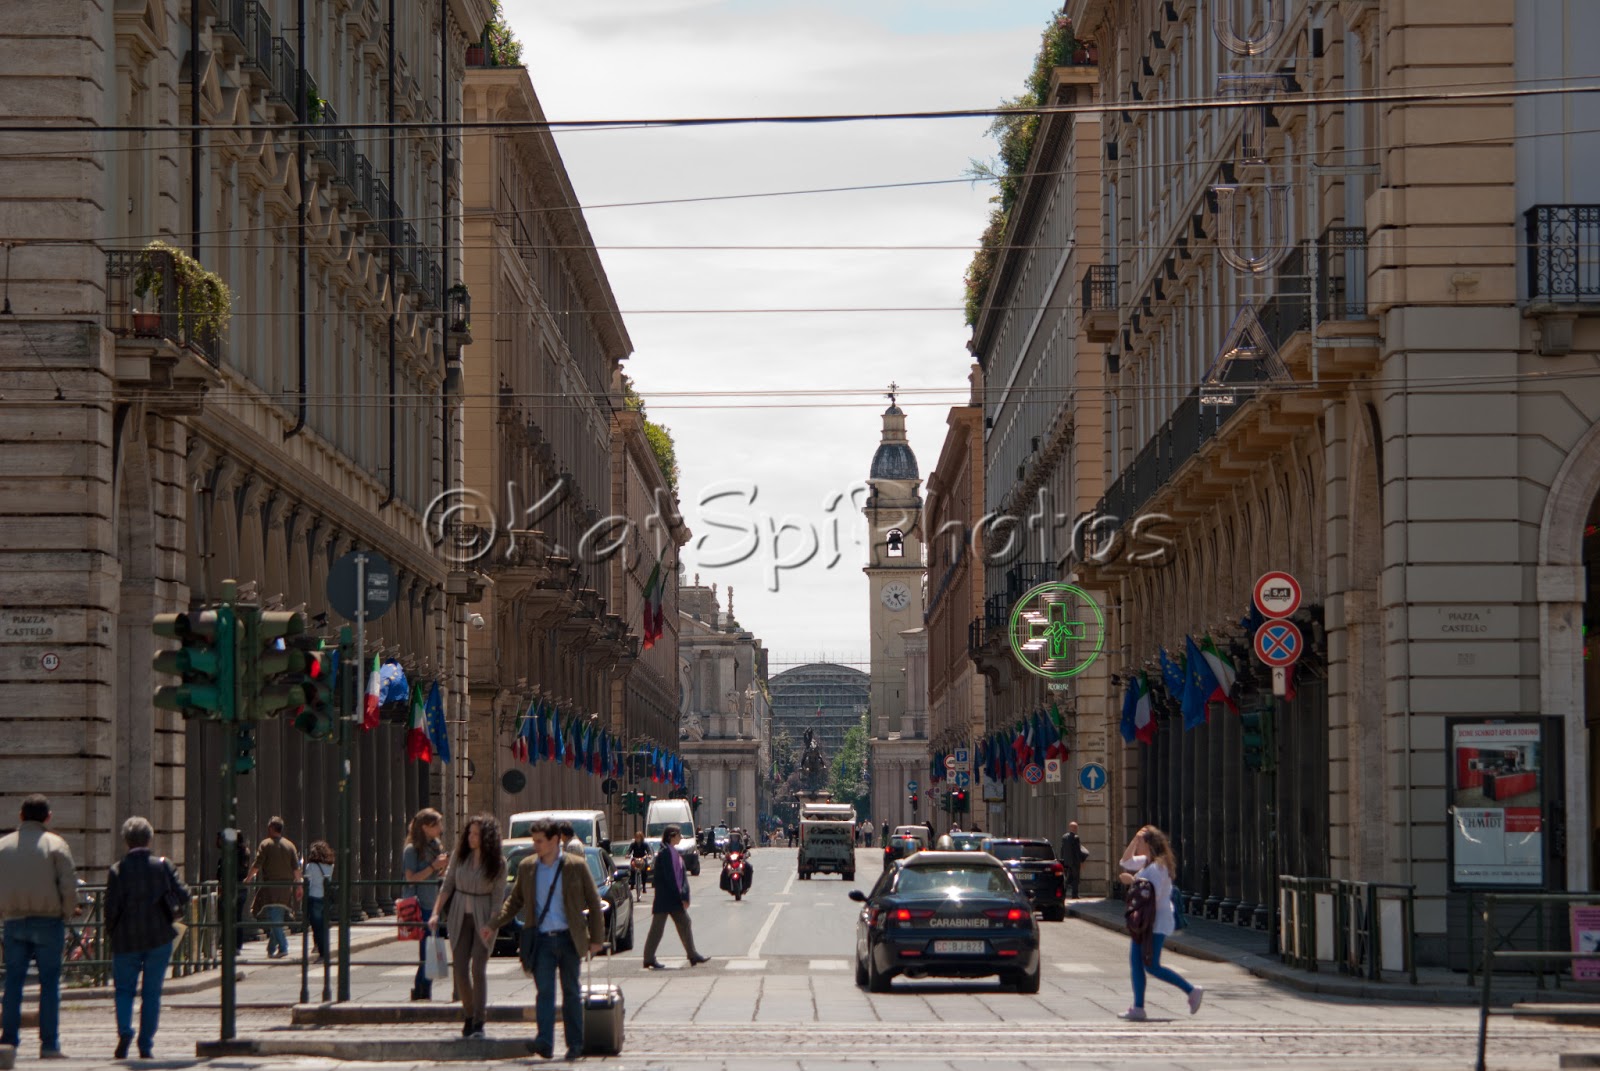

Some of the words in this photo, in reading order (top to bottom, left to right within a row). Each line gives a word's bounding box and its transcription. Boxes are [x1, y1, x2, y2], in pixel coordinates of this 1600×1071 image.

[12, 616, 46, 624] PIAZZA
[1448, 612, 1480, 621] PIAZZA
[5, 627, 54, 636] CASTELLO
[1441, 624, 1488, 633] CASTELLO
[930, 918, 989, 928] CARABINIERI
